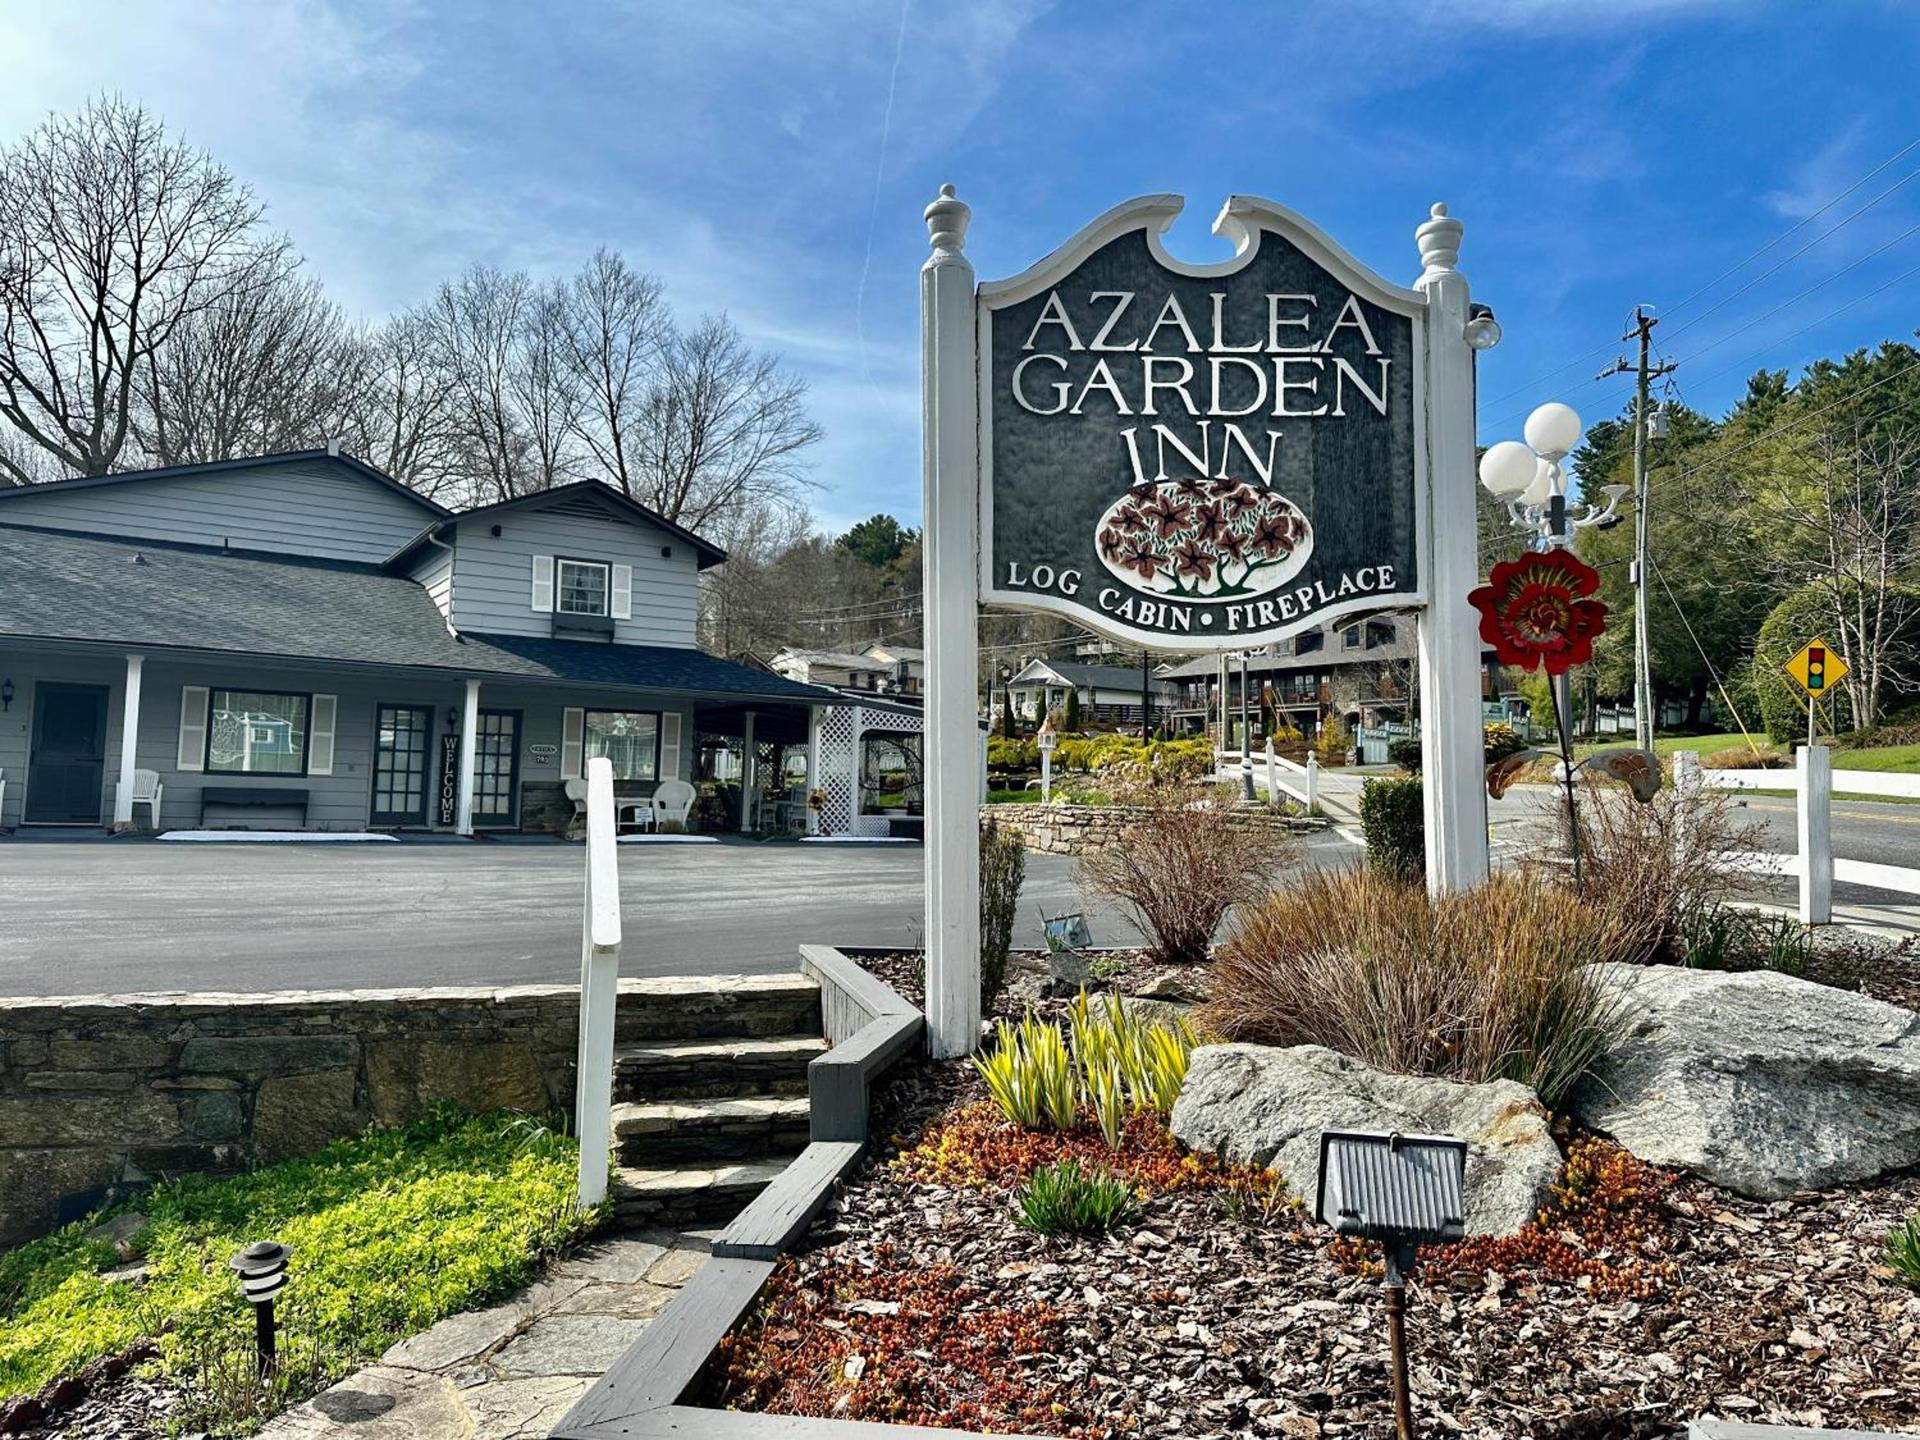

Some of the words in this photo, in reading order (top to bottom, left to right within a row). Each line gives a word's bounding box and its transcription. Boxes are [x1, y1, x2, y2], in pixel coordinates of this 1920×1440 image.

[1022, 290, 1383, 355] AZALEA
[1011, 353, 1393, 417] GARDEN
[1120, 420, 1283, 488] INN
[1007, 561, 1082, 595] LOG
[1099, 588, 1193, 632] CABIN
[1226, 564, 1397, 631] FIREPLACE
[441, 736, 458, 823] WELCOME
